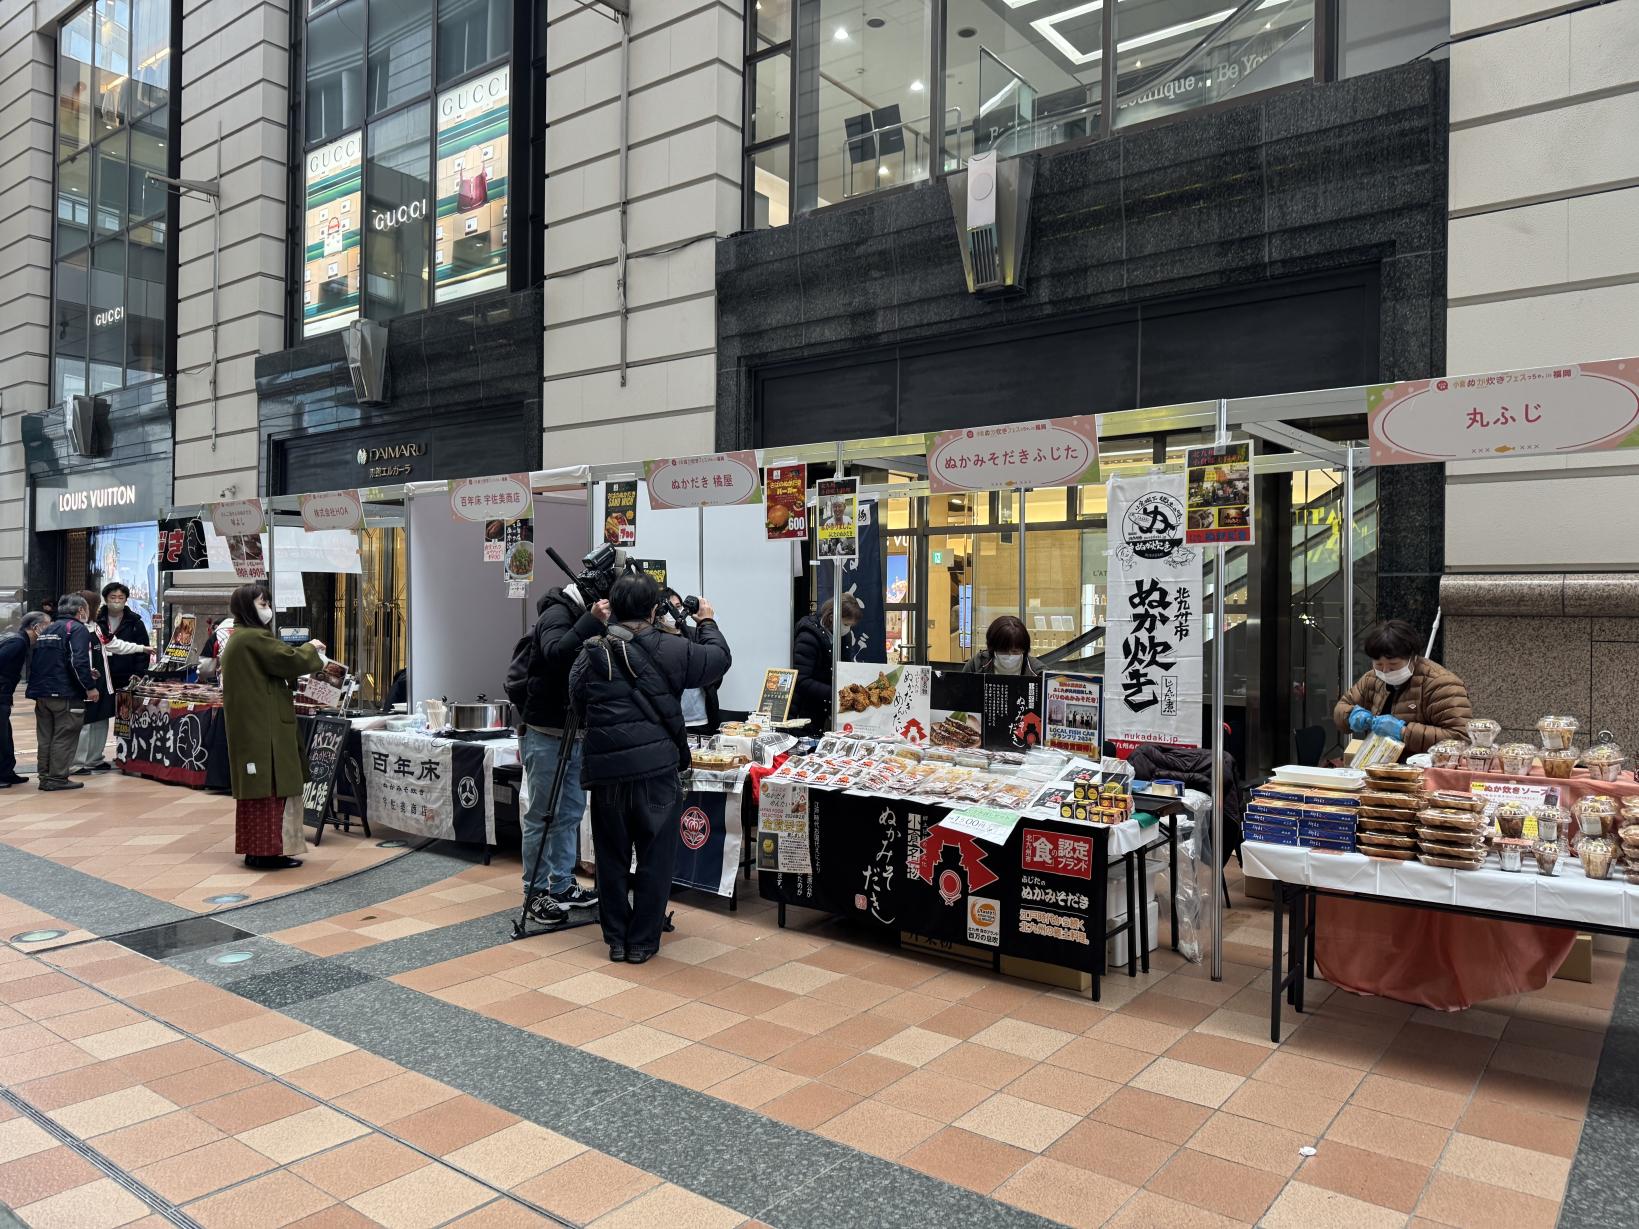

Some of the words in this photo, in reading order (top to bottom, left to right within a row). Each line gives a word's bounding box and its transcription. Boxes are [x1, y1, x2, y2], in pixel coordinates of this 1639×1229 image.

[1217, 62, 1240, 82] Be
[442, 73, 509, 117] GUCCI
[310, 137, 361, 173] GUCCI
[374, 199, 427, 231] GUCCI
[95, 306, 124, 326] GUCCI
[1466, 403, 1542, 430] 丸ふじ
[370, 442, 427, 461] DAIMARU
[944, 444, 1079, 469] ぬかみそだきふじた
[671, 473, 709, 490] ぬかだき
[59, 491, 88, 512] LOUIS
[90, 485, 136, 508] VUITTON
[460, 495, 482, 507] 百年床
[313, 508, 349, 518] 株式会社HOA
[788, 517, 805, 531] 600
[1174, 586, 1192, 643] 北九州市
[1121, 577, 1177, 713] ぬか炊き
[1049, 727, 1068, 735] LOCAL
[1124, 732, 1179, 743] nukadaki.jp
[371, 751, 441, 781] 百年床
[907, 813, 921, 881] 小倉名物
[863, 806, 902, 924] ぬかみそだき
[1058, 857, 1088, 871] ブランド
[1021, 875, 1046, 886] ふじたの
[1021, 885, 1089, 909] ぬかみそだき
[1019, 908, 1085, 931] 江戸時代から続く
